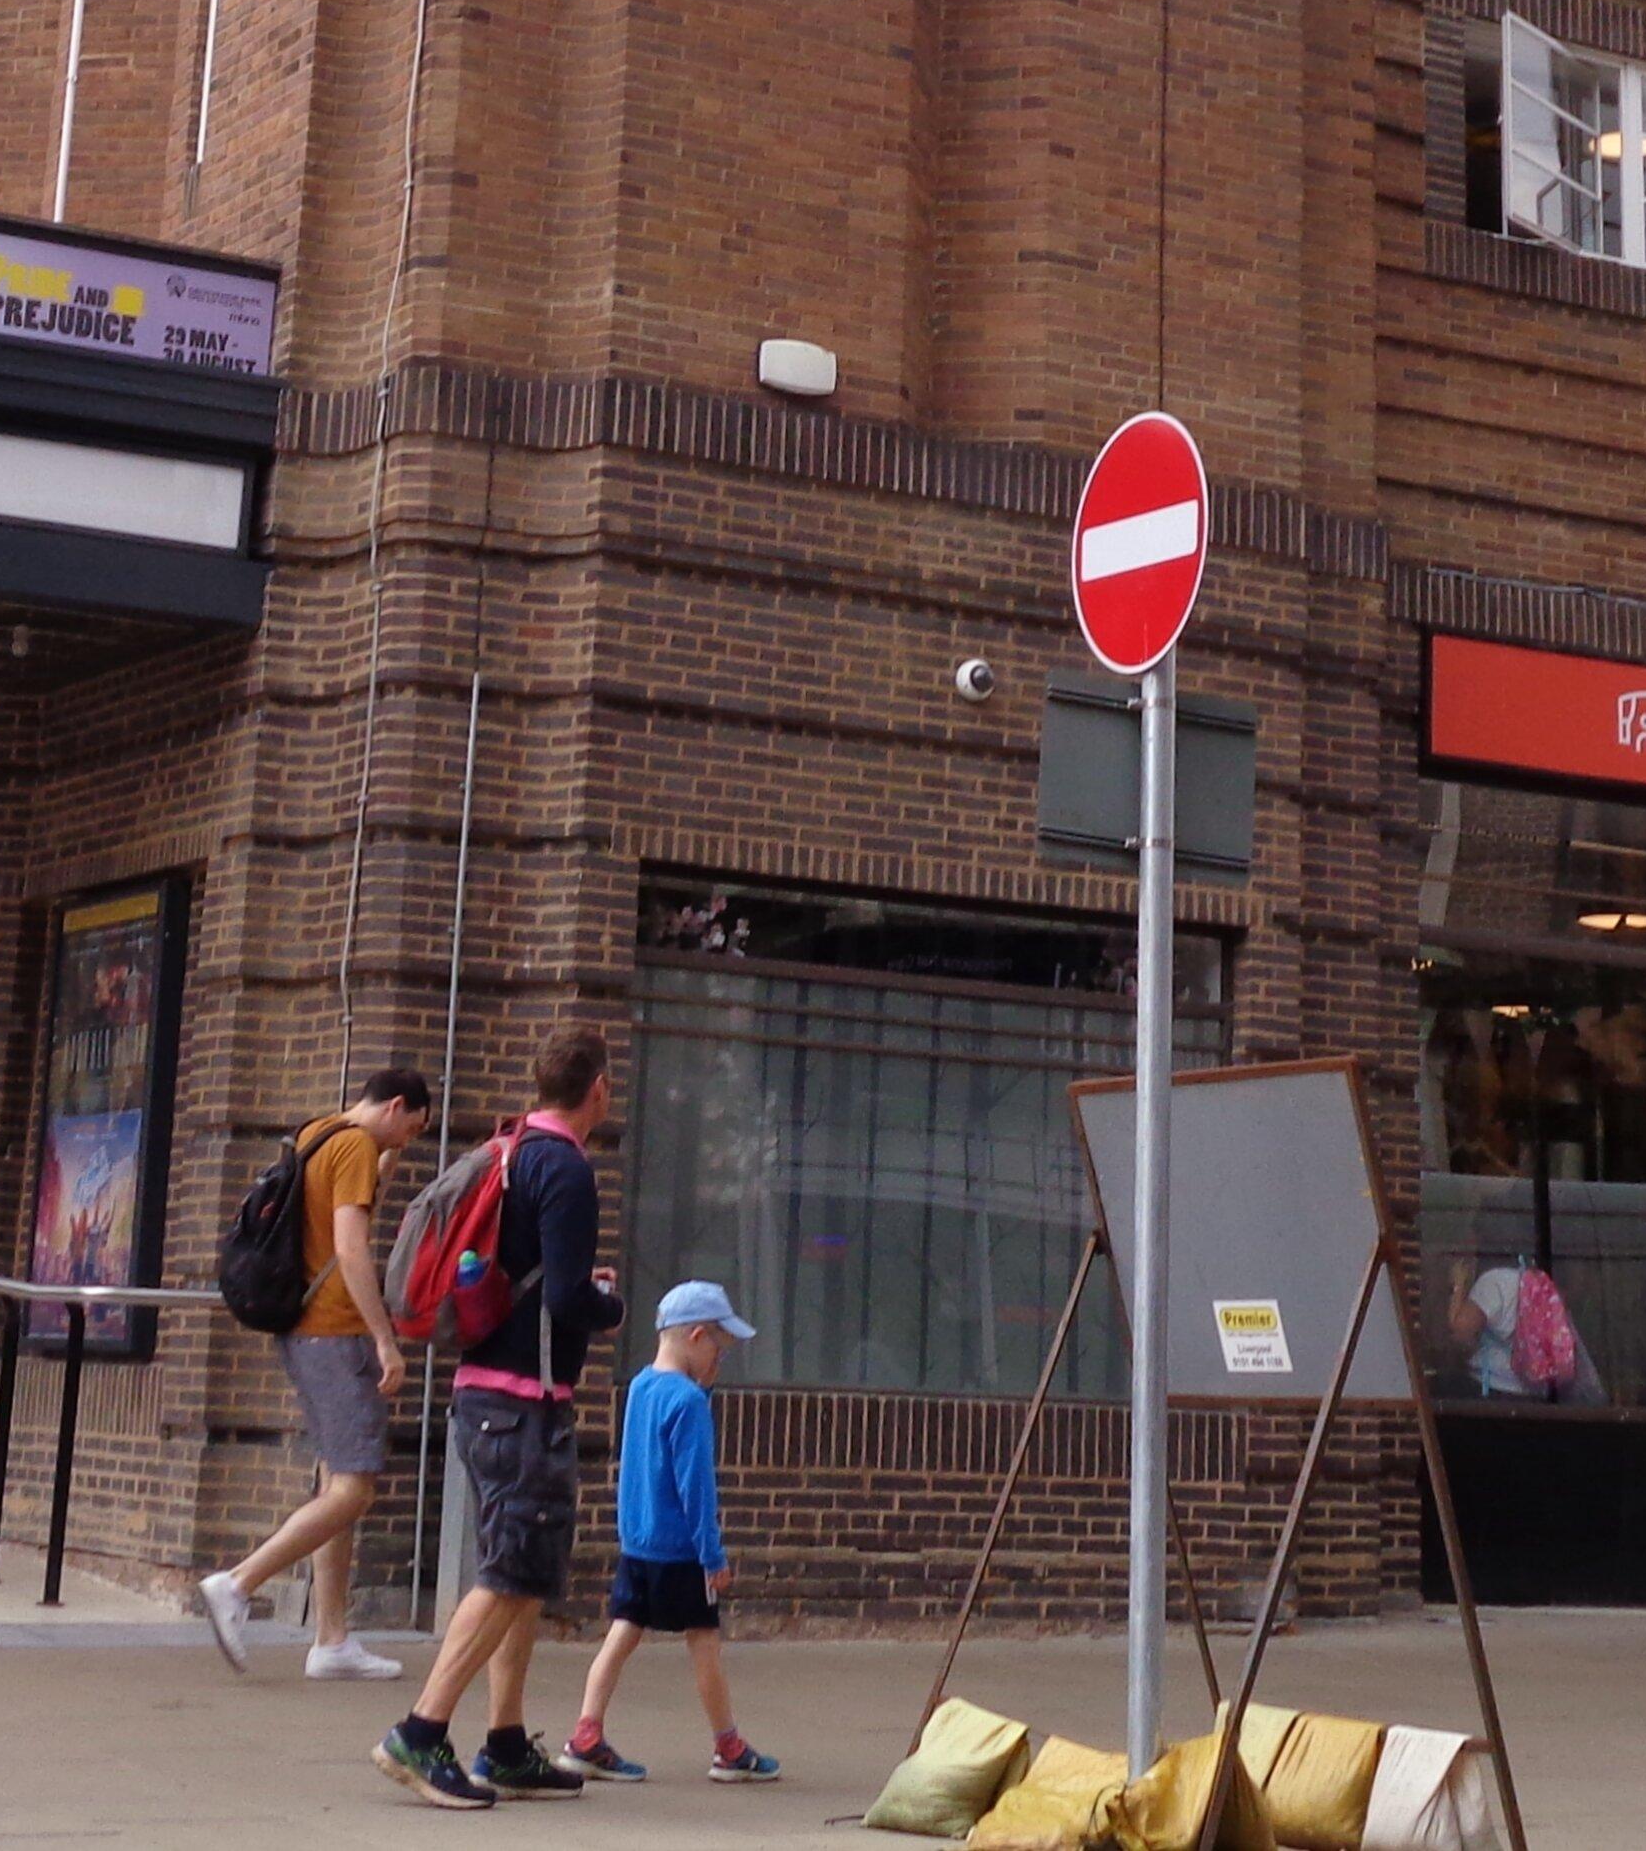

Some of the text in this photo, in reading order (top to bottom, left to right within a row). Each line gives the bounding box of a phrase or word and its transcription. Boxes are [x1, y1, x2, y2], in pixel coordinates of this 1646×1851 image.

[73, 285, 109, 308] AND
[189, 329, 229, 352] MAY
[1223, 1311, 1272, 1327] Premier
